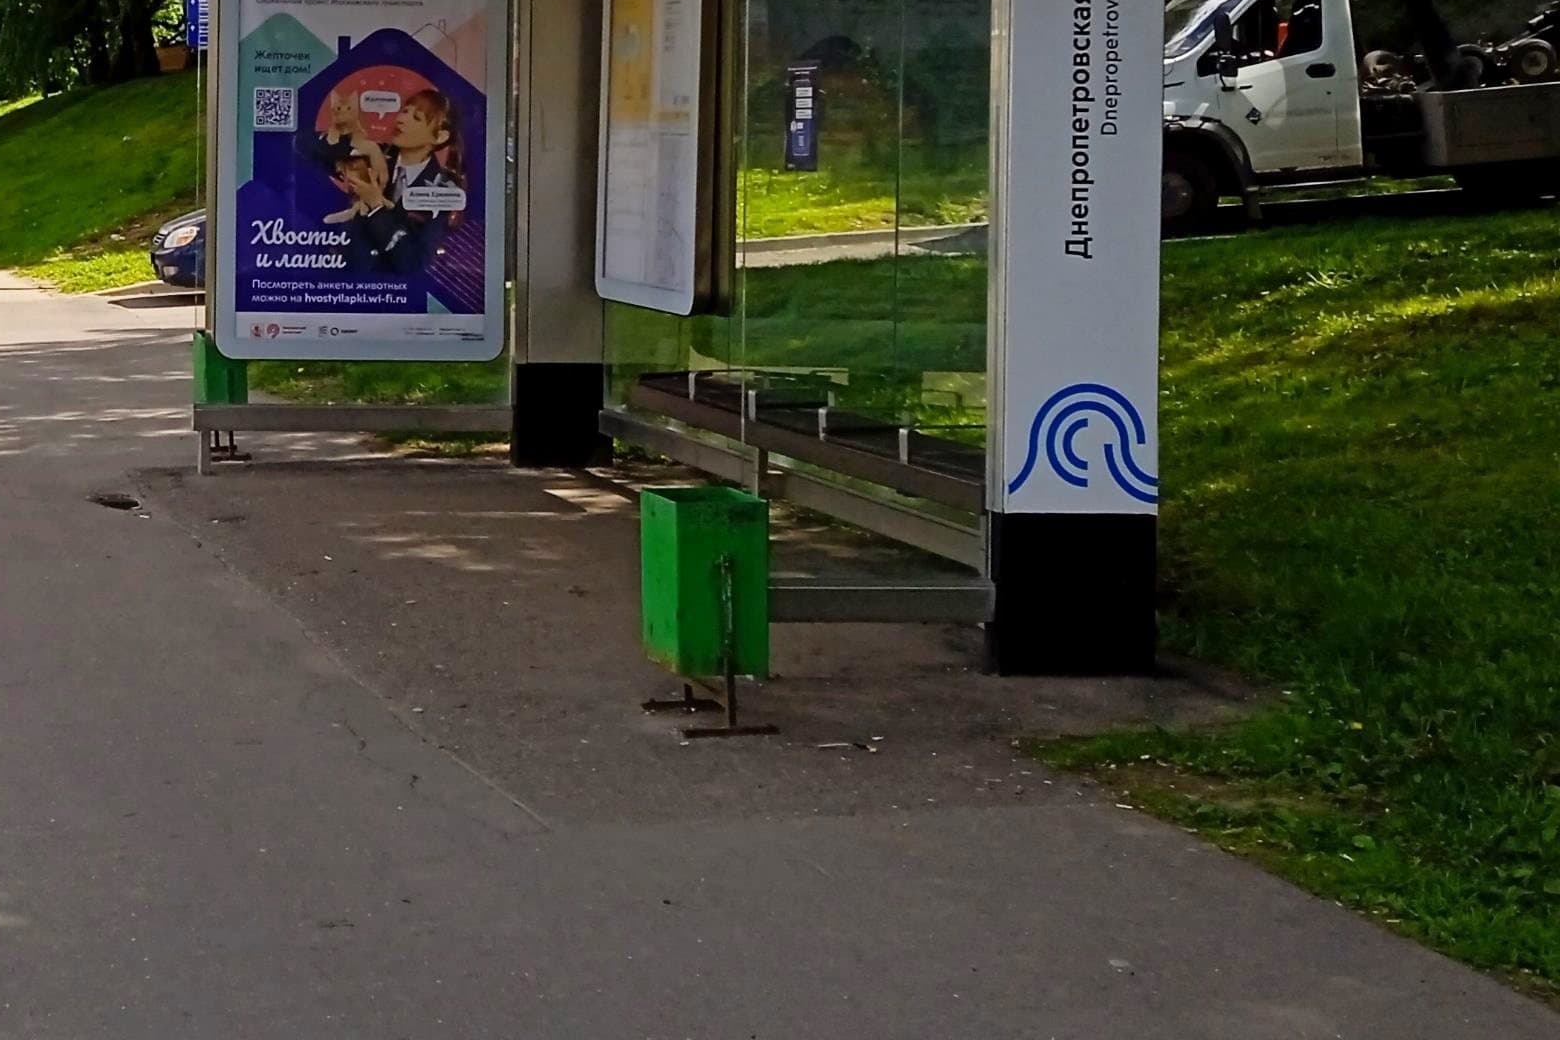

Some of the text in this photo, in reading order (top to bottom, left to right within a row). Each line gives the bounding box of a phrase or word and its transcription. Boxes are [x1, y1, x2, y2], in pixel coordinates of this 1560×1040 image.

[254, 63, 312, 74] ищет дом!
[251, 218, 352, 246] Хвосты
[256, 253, 347, 269] и лапки
[252, 279, 408, 291] Посмотреть анкеты животных
